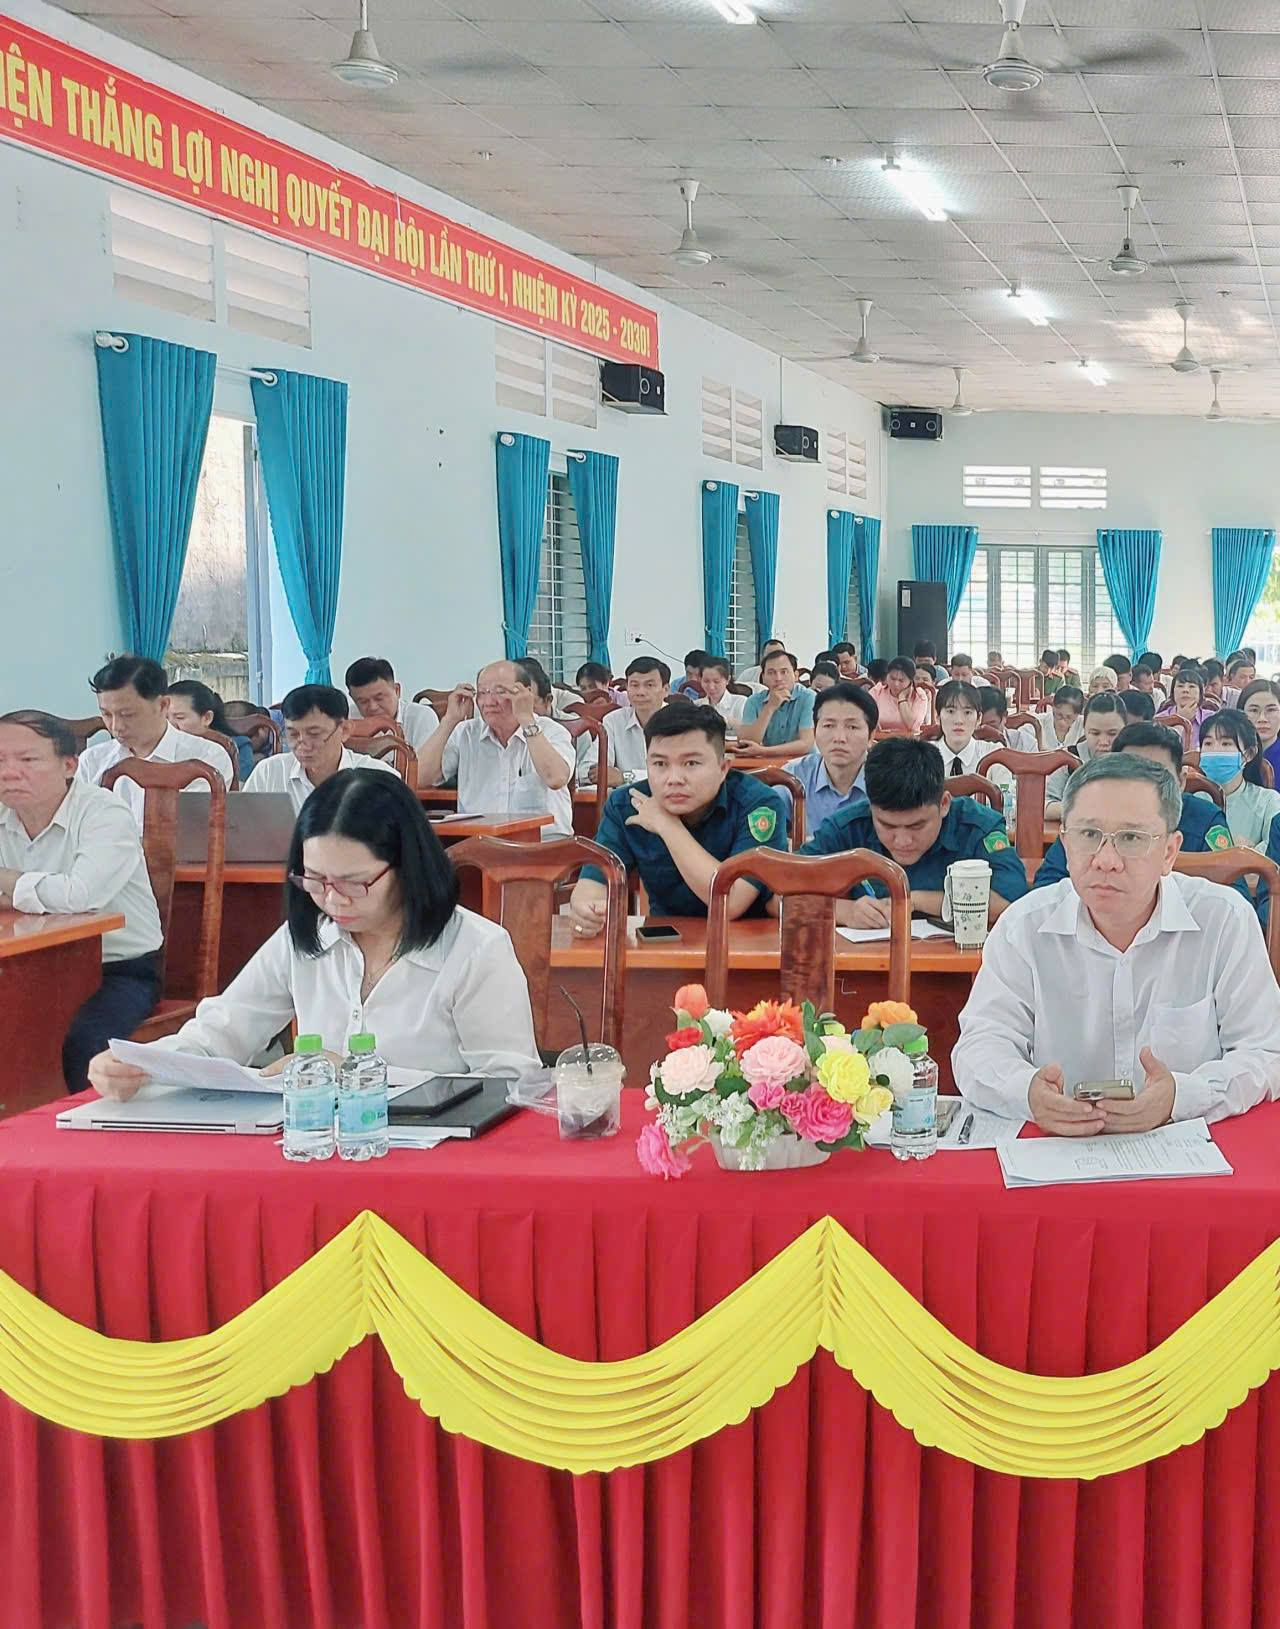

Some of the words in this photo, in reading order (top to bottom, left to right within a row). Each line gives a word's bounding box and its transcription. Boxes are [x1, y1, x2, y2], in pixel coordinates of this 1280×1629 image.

[171, 124, 213, 195] LỢI
[220, 144, 279, 224] NGHỊ
[286, 172, 352, 240] QUYẾT
[357, 203, 390, 263] ĐẠI
[394, 216, 425, 277] HỘI
[430, 225, 462, 285] LẦN
[466, 250, 496, 297] THỨ
[498, 263, 509, 307] I,
[512, 269, 558, 325] NHIỆM
[561, 287, 578, 328] KỲ
[580, 299, 610, 342] 2025
[620, 316, 651, 358] 2030!
